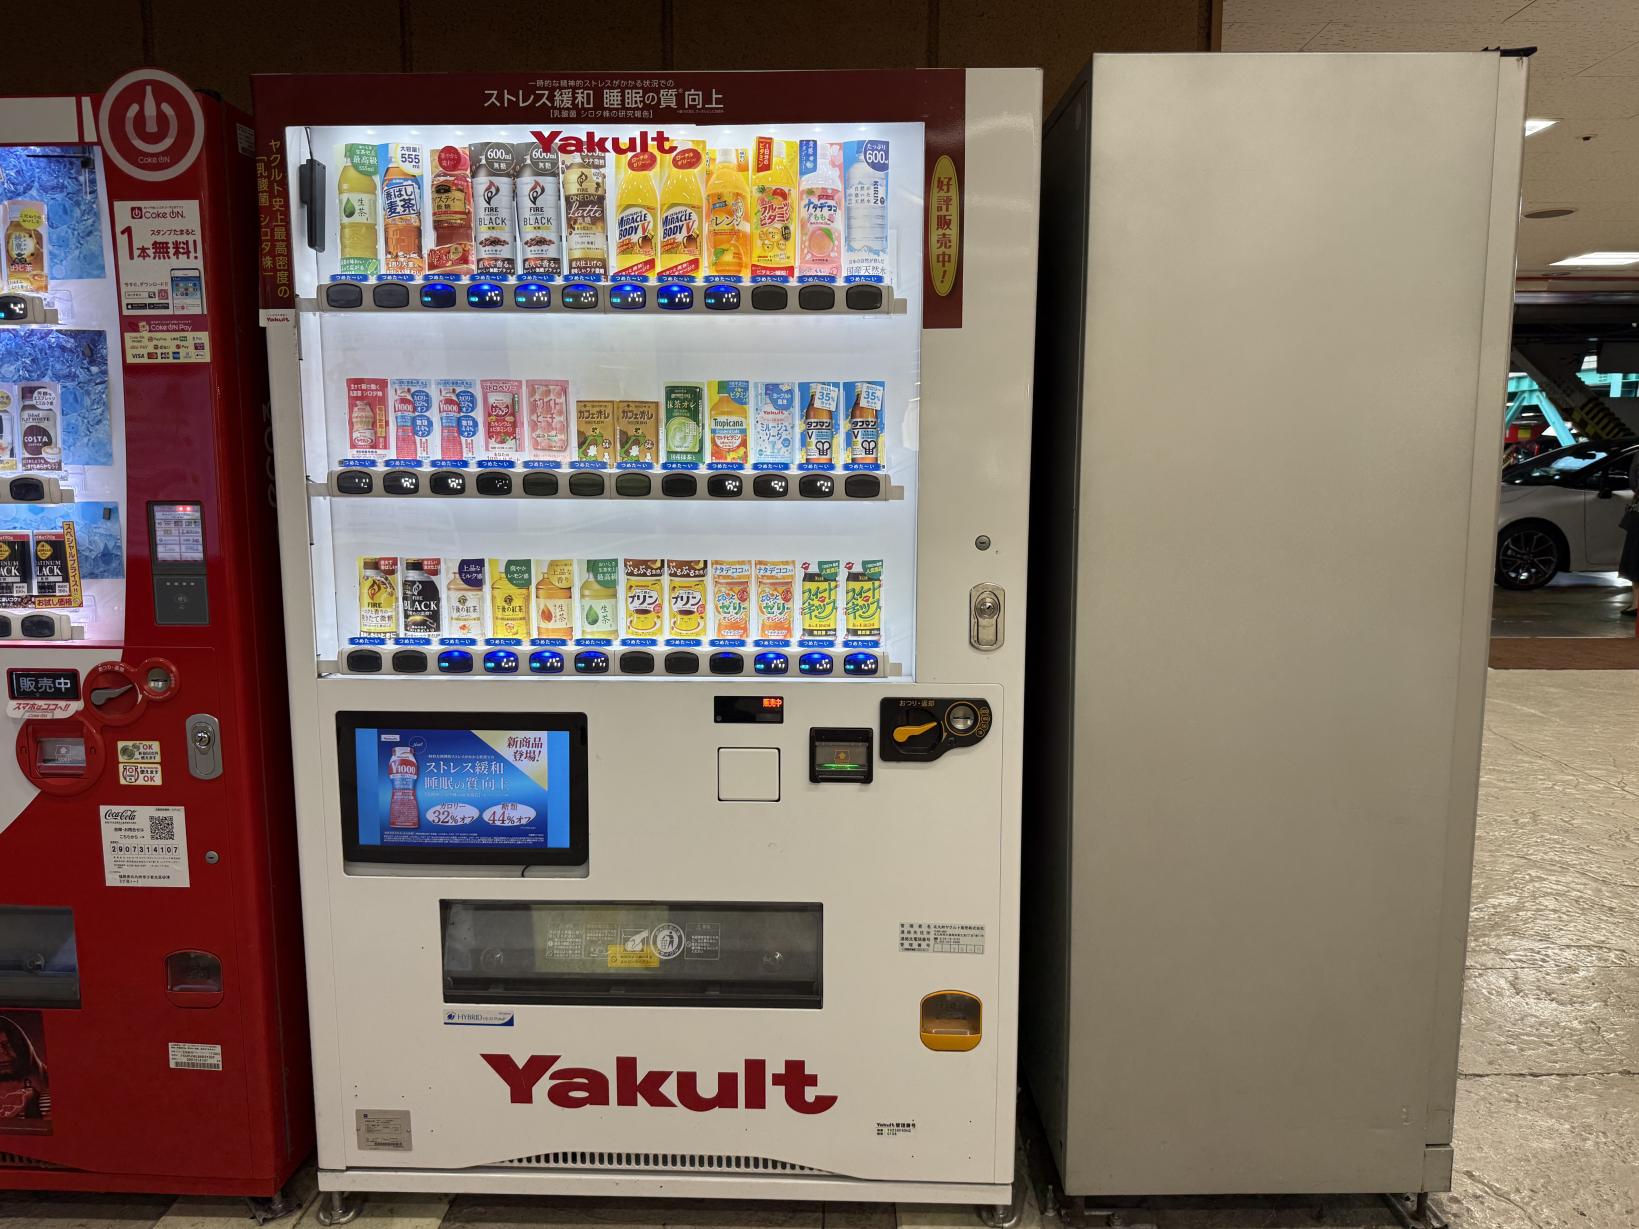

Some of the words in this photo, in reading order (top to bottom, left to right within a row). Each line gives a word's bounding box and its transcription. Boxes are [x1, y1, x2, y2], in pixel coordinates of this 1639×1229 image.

[528, 80, 675, 88] 一時的な精神的ストレスがかかる状況での
[484, 89, 594, 109] ストレス緩和
[530, 130, 681, 155] Yakult
[138, 156, 157, 164] Coke
[400, 153, 421, 164] 555
[487, 148, 512, 160] 600ml
[866, 150, 885, 164] 600
[387, 198, 416, 217] 麦茶
[567, 202, 603, 218] Latte
[761, 201, 789, 216] フルーツ
[804, 199, 838, 212] ナタデココ
[144, 210, 168, 219] Coke
[269, 140, 290, 298] ヤクルト史上最高密度の
[618, 212, 648, 230] MIRACLE
[662, 212, 693, 229] MIRACLE
[479, 217, 507, 226] BLACK
[524, 217, 553, 226] BLACK
[618, 228, 640, 241] BODY
[663, 227, 684, 240] BODY
[936, 176, 953, 284] 好評販売中!
[179, 324, 193, 332] Pay
[713, 419, 744, 428] Tropicana
[807, 431, 814, 440] V
[853, 431, 860, 440] V
[404, 601, 438, 611] BLACK
[628, 595, 658, 606] プリン
[672, 595, 702, 606] プリン
[720, 603, 748, 615] ゼリー
[763, 602, 791, 615] ゼリー
[19, 677, 71, 693] 販売中
[507, 736, 544, 750] 新商品
[513, 749, 542, 763] 登場!
[391, 763, 416, 776] Y1000
[425, 761, 504, 775] ストレス緩和
[424, 776, 509, 791] 睡眠の質向上
[439, 802, 467, 810] カロリー
[432, 810, 476, 825] 32%オフ
[488, 811, 531, 825] 44%オフ
[479, 1053, 839, 1115] Yakult
